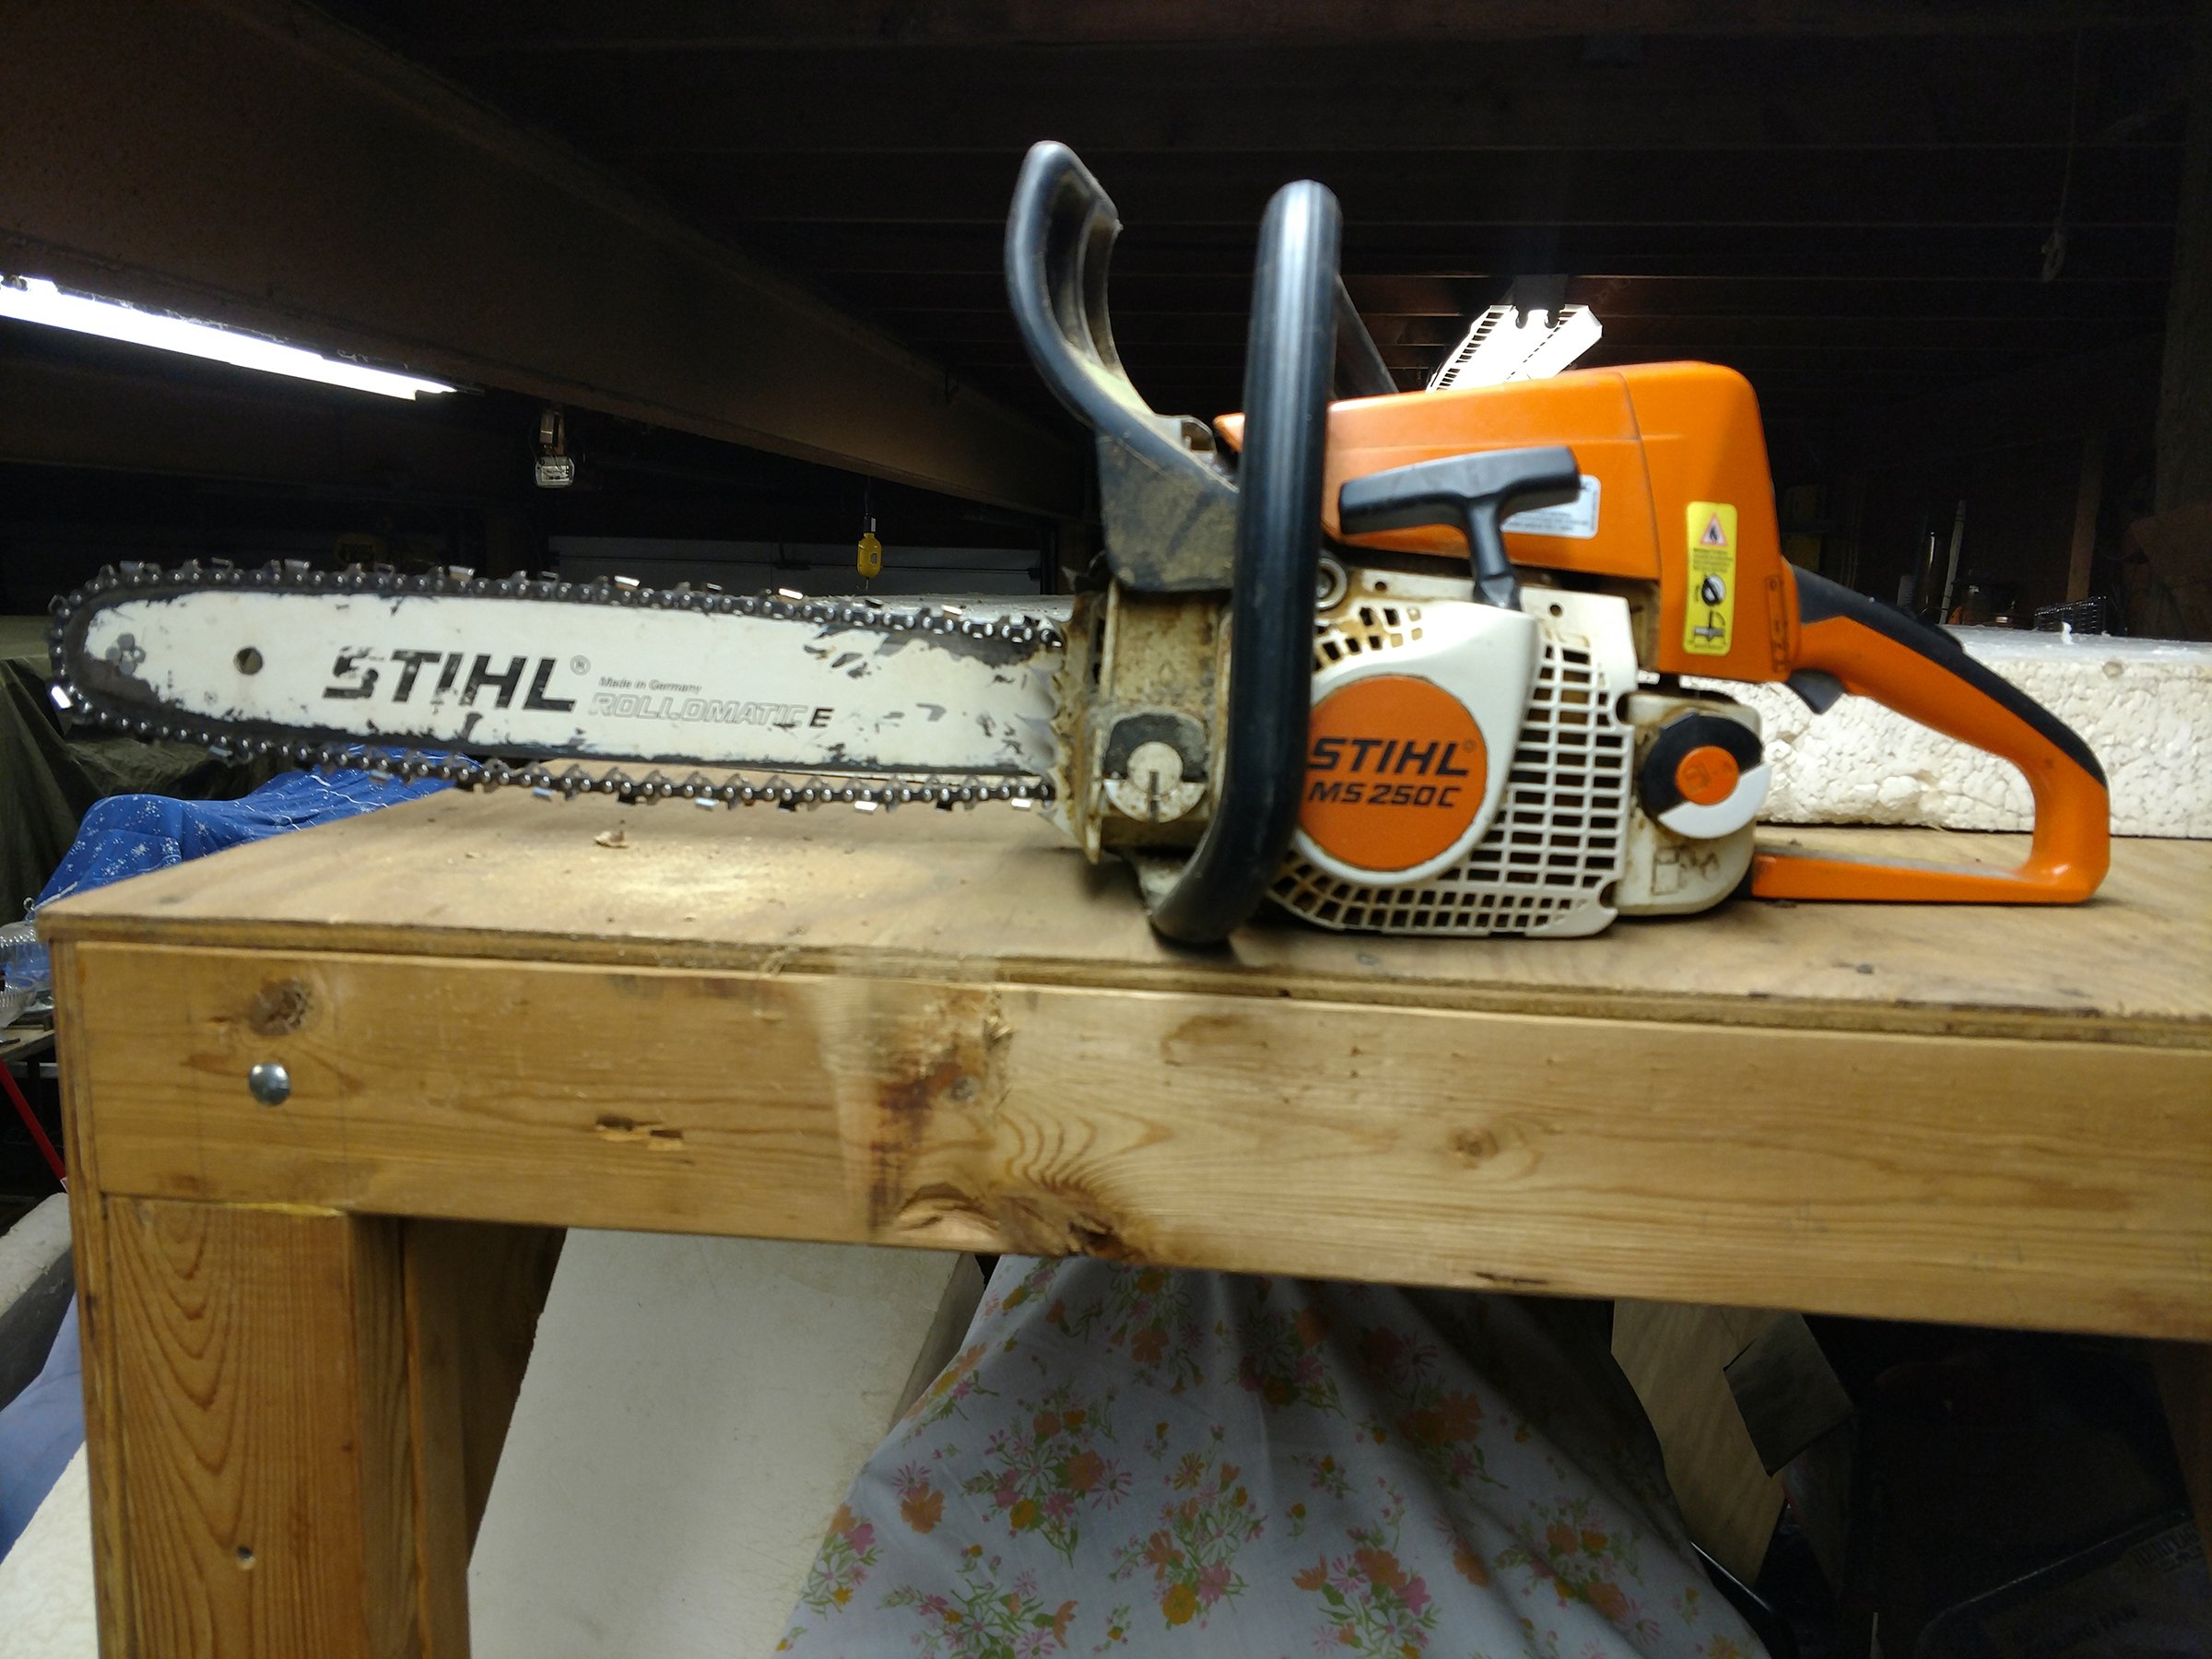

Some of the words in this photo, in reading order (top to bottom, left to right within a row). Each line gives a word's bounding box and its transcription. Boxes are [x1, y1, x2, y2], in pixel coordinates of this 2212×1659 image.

[323, 645, 577, 712] STIHL
[598, 676, 633, 690] Made
[635, 680, 646, 690] in
[648, 678, 703, 695] Germany
[589, 692, 809, 727] ROLLOMATIC
[809, 706, 835, 728] E
[1308, 737, 1470, 777] STIHL
